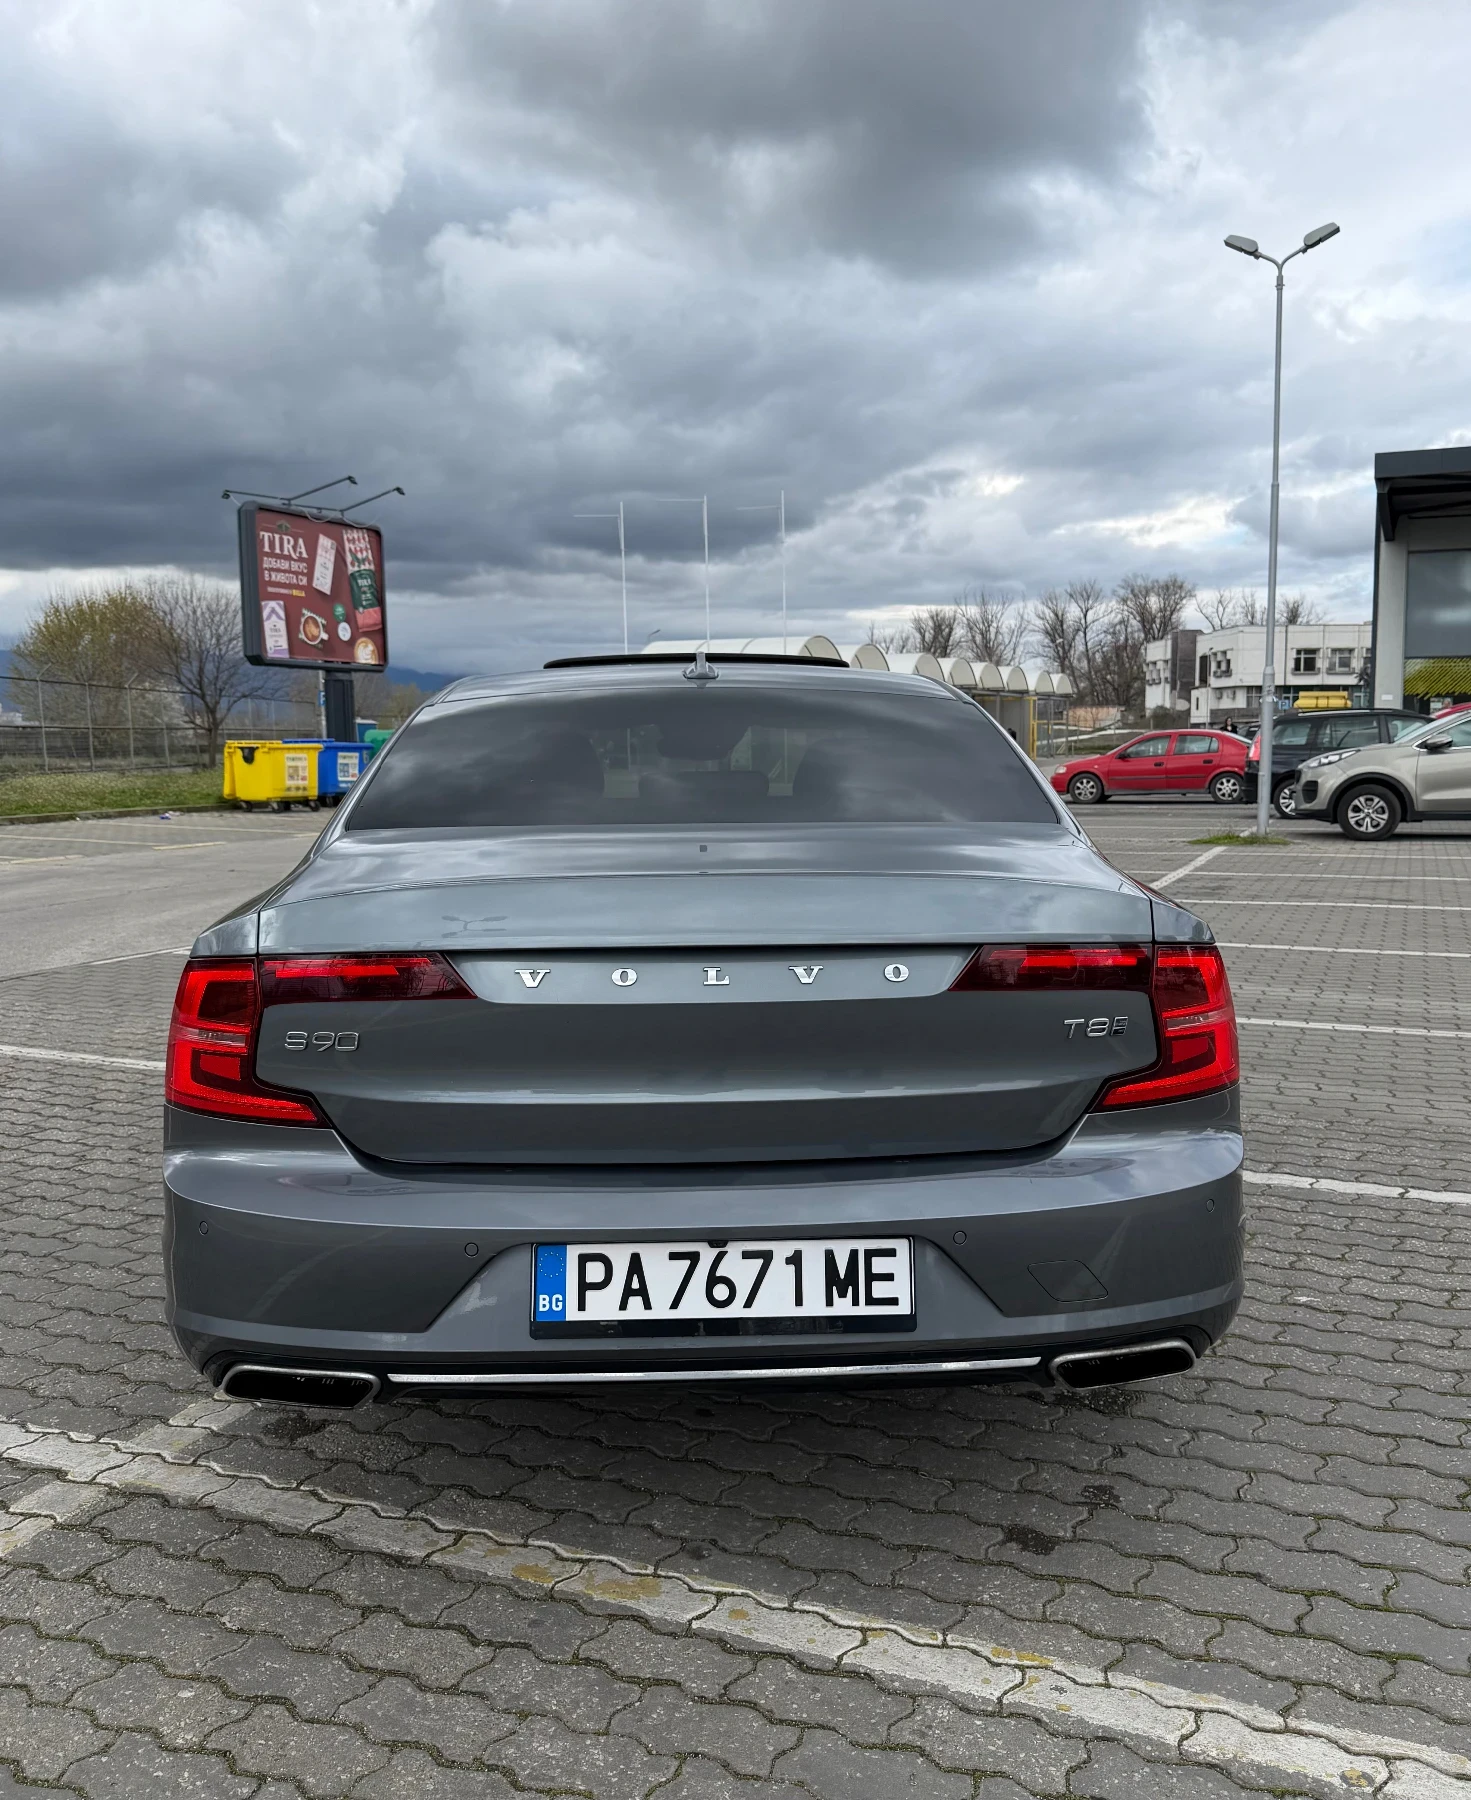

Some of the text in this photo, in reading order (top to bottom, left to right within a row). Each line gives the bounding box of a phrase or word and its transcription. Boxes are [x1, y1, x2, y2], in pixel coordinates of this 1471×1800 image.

[259, 531, 309, 559] TIRA
[263, 557, 308, 573] ДОБАВИ ВКУС
[264, 571, 308, 586] В ЖИВОТА СИ
[514, 963, 910, 988] VOLVO
[284, 1031, 360, 1052] S90
[538, 1293, 563, 1312] BG
